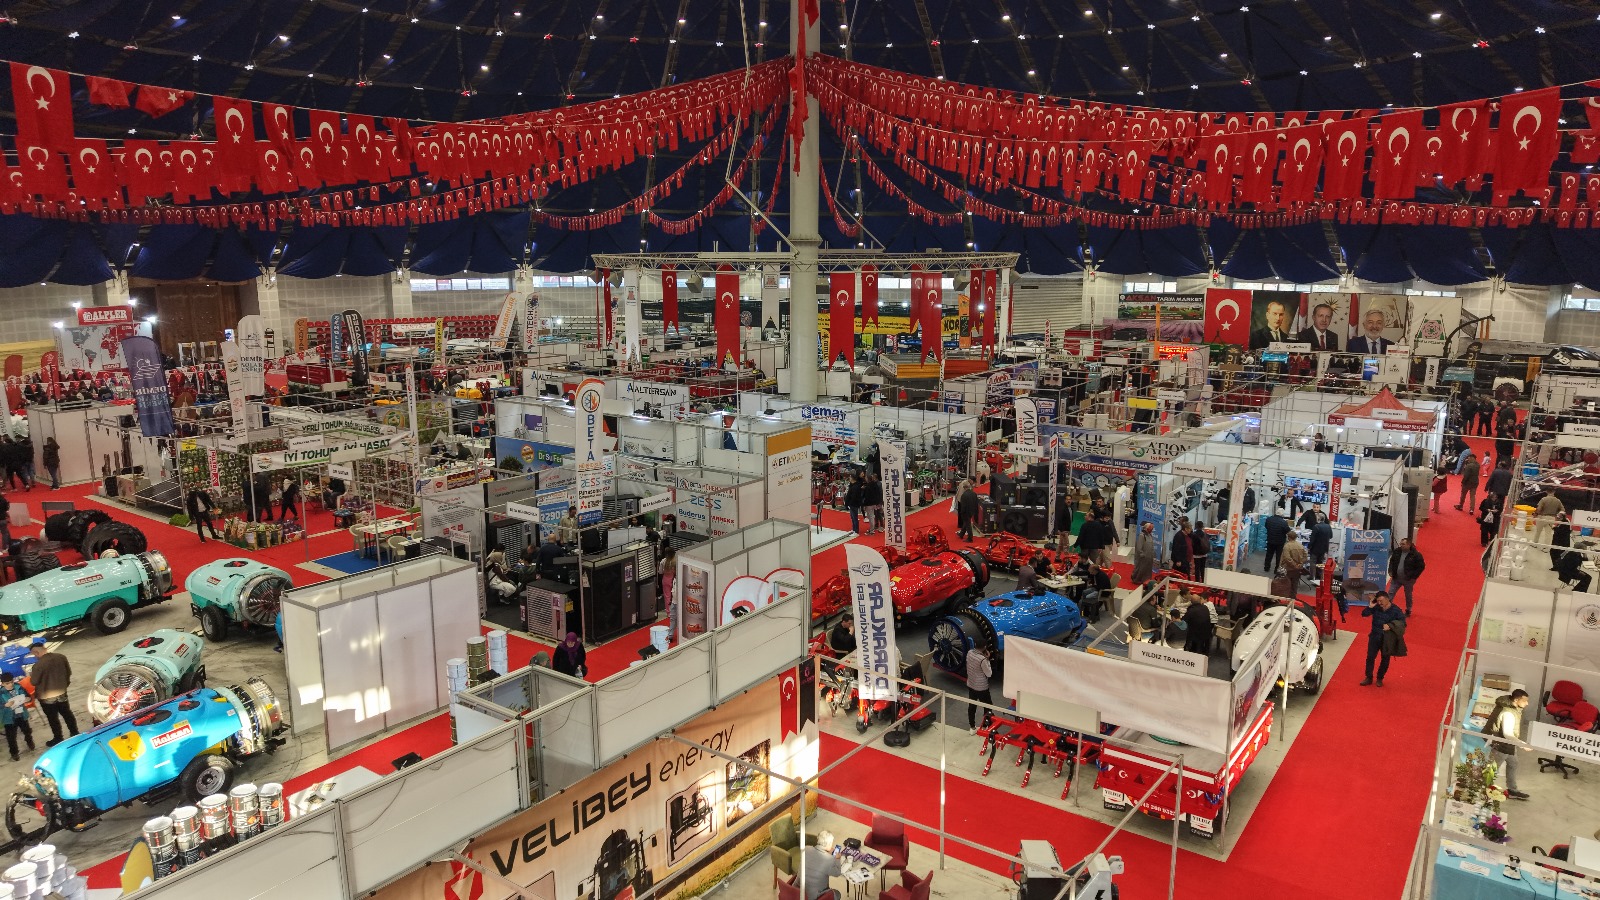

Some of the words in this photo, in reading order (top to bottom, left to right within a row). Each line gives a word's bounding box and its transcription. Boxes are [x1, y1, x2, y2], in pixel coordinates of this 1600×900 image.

[92, 309, 127, 321] ALPLER
[320, 420, 343, 430] TOHUM
[586, 414, 595, 461] BETA
[1071, 431, 1110, 448] KUL
[283, 449, 298, 462] İYİ
[1070, 444, 1111, 456] ENERJİ
[1142, 499, 1163, 512] INOX
[678, 508, 706, 520] Buderus
[1351, 530, 1385, 539] INOX
[1141, 650, 1162, 660] YILDIZ
[1163, 654, 1196, 668] TRAKTÖR
[152, 726, 192, 747] Holsan
[1548, 730, 1582, 743] ISUBÜ
[1556, 741, 1600, 758] FAKÜLT
[489, 762, 652, 877] VELİBEY
[659, 724, 735, 782] energy
